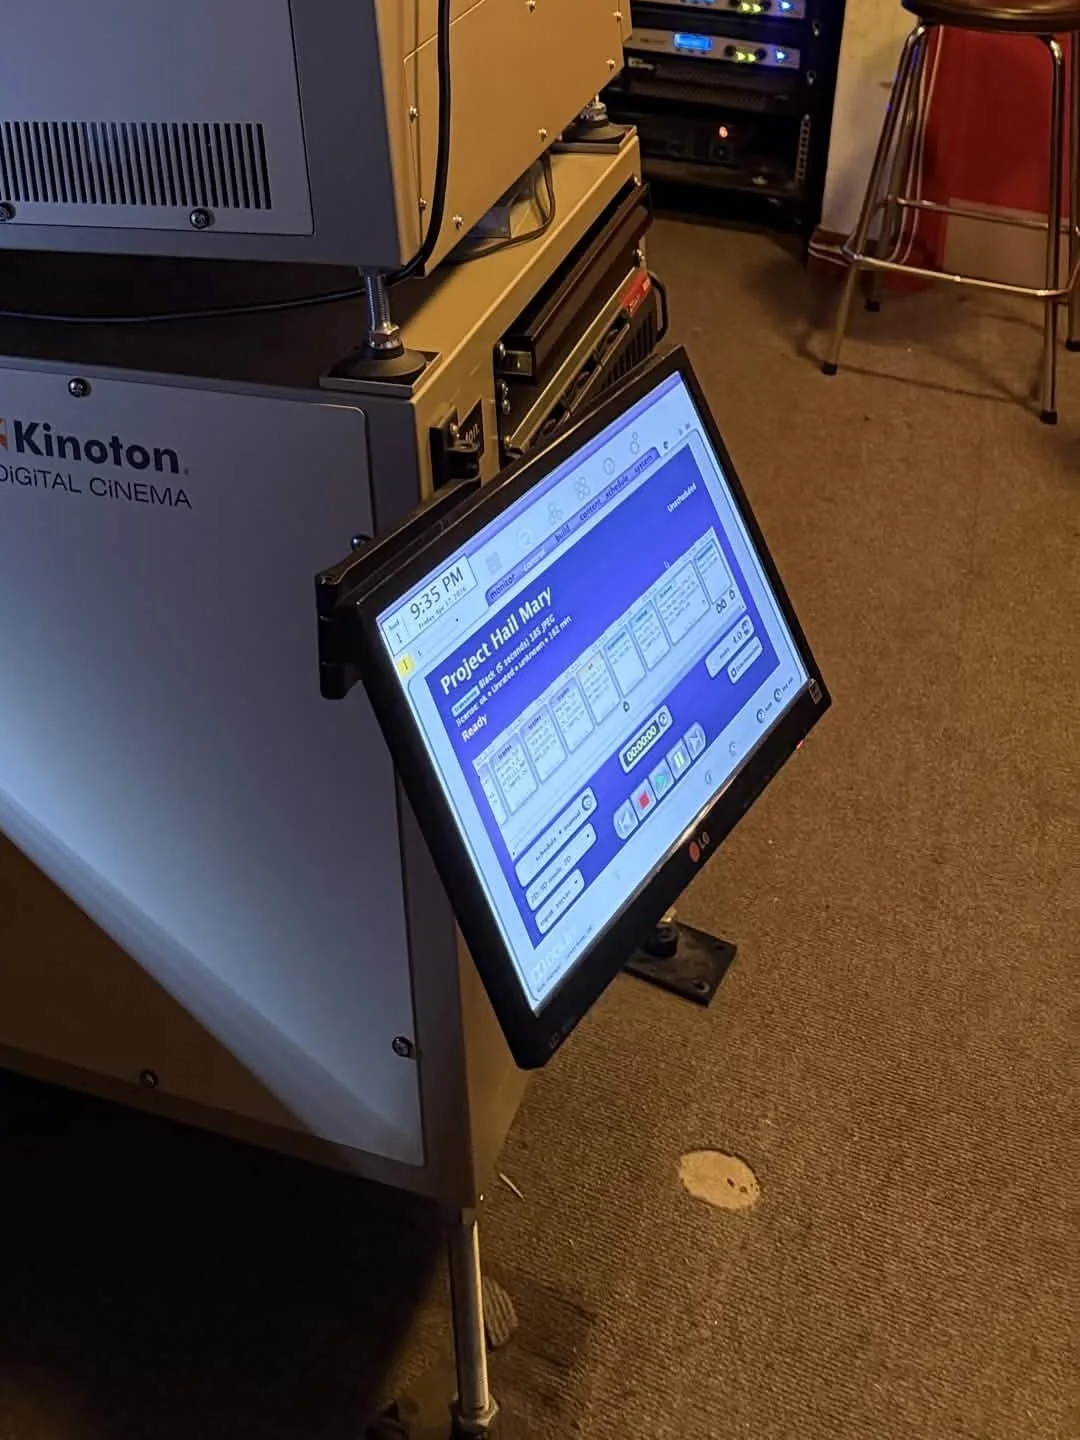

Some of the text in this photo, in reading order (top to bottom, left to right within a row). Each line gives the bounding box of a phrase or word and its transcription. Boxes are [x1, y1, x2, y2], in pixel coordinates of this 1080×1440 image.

[12, 419, 181, 474] Kinoton
[667, 482, 696, 512] Unscheduled
[489, 573, 514, 599] monitor
[554, 523, 570, 542] build
[605, 475, 628, 498] schedule
[634, 455, 654, 476] system
[410, 566, 463, 619] 9:35 PM
[440, 587, 550, 694] Project Hail Mary
[478, 670, 495, 688] Black
[503, 637, 529, 666] seconds)
[490, 667, 514, 692] Unrated
[518, 641, 544, 667] unknown
[559, 615, 571, 629] min
[461, 714, 487, 741] Ready
[626, 725, 656, 761] 00:00:00
